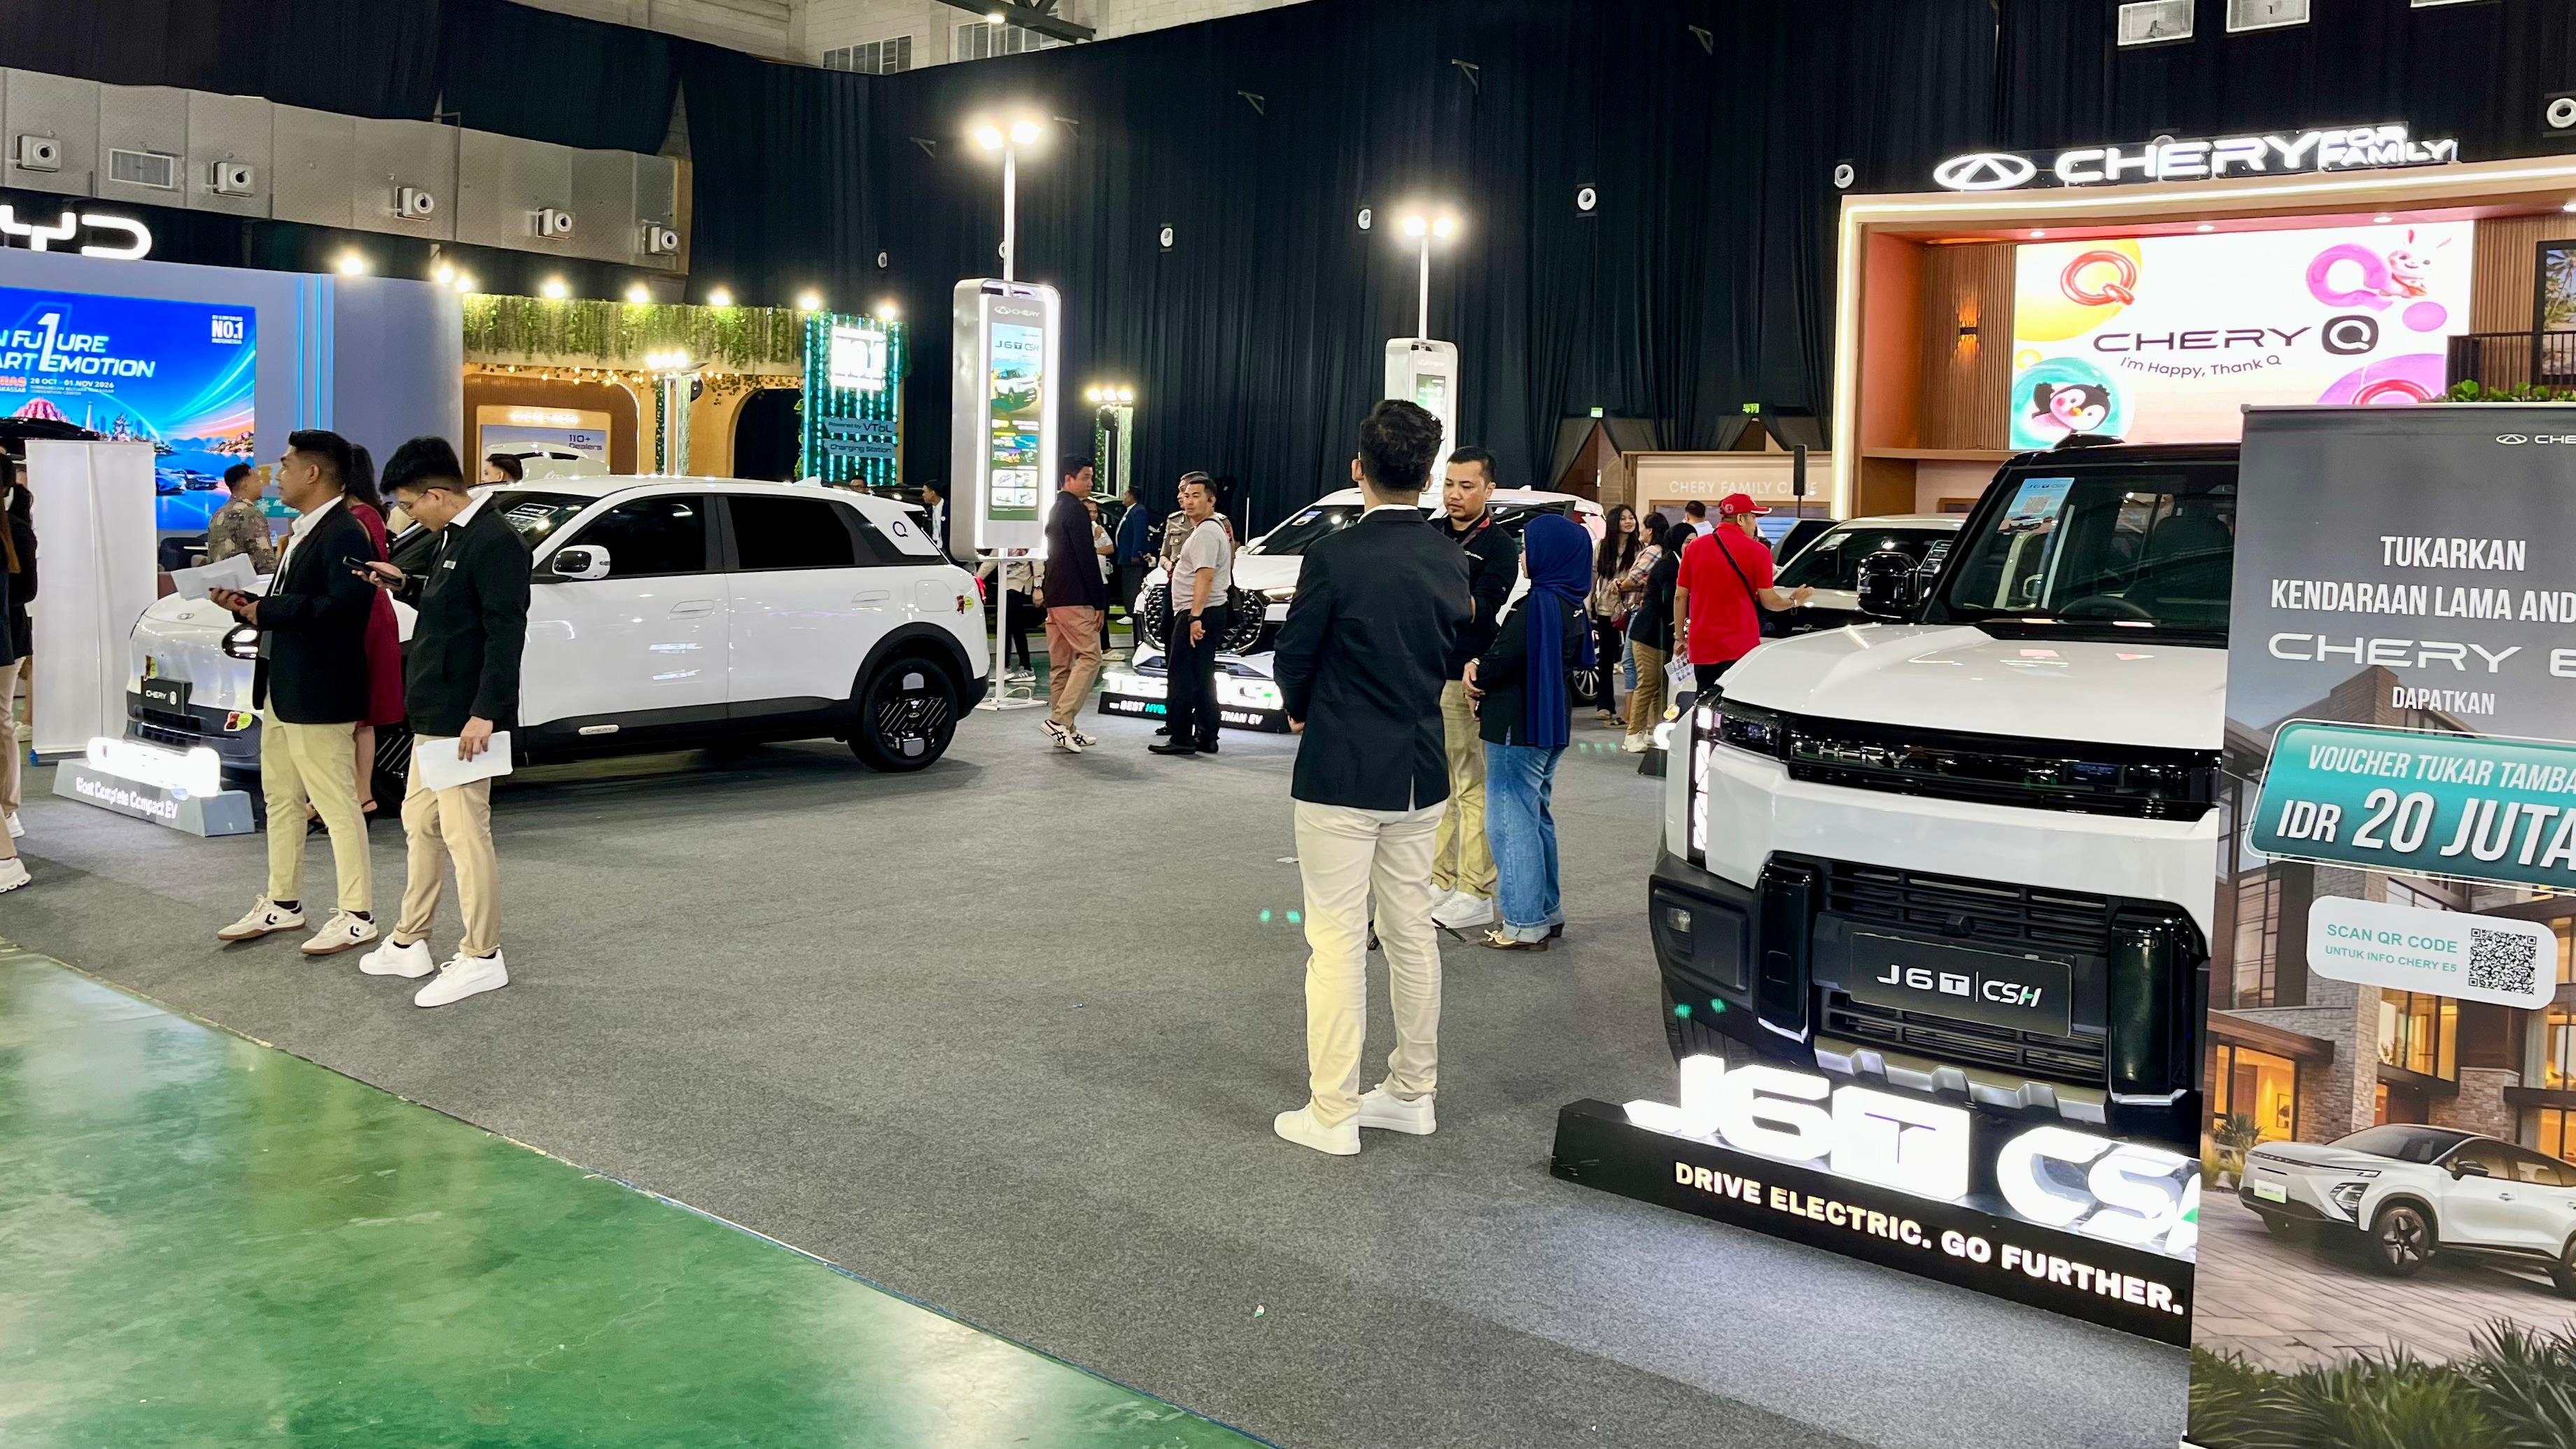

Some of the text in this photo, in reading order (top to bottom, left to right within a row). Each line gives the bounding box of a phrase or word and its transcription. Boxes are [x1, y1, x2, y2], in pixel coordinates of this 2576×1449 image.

[2319, 127, 2407, 149] FOR
[2054, 133, 2320, 182] CHERY
[2319, 139, 2454, 172] FAMILY
[212, 320, 243, 339] NO.1
[2093, 318, 2372, 352] CHERY Q
[0, 351, 155, 378] RT EMOTION
[2120, 355, 2282, 379] I'm Happy, Thank Q
[569, 434, 591, 442] 110+
[830, 444, 864, 453] Charging
[1669, 481, 1715, 493] CHERY
[1721, 481, 1772, 494] FAMILY
[2380, 536, 2526, 571] TUKARKAN
[2270, 579, 2428, 616] KENDARAAN
[2434, 586, 2512, 621] LAMA
[2268, 632, 2523, 673] CHERY
[146, 690, 167, 700] CHERY
[2391, 686, 2496, 715] DAPATKAN
[1120, 699, 1145, 712] BEST
[1144, 703, 1167, 714] HYB
[1220, 710, 1247, 724] THAN
[1247, 713, 1263, 725] EV
[2309, 744, 2410, 778] VOUCHER
[2415, 755, 2493, 786] TUKAR
[94, 781, 129, 806] Complete
[130, 791, 164, 816] Compact
[165, 800, 178, 819] EV
[2276, 788, 2576, 871] IDR 20 JUTA
[2327, 924, 2458, 953] SCAN QR CODE
[2325, 945, 2458, 972] UNTUK INFO CHERY E5
[1982, 980, 2042, 1007] CSH
[1675, 1161, 2184, 1316] DRIVE ELECTRIC. GO FURTHER.
